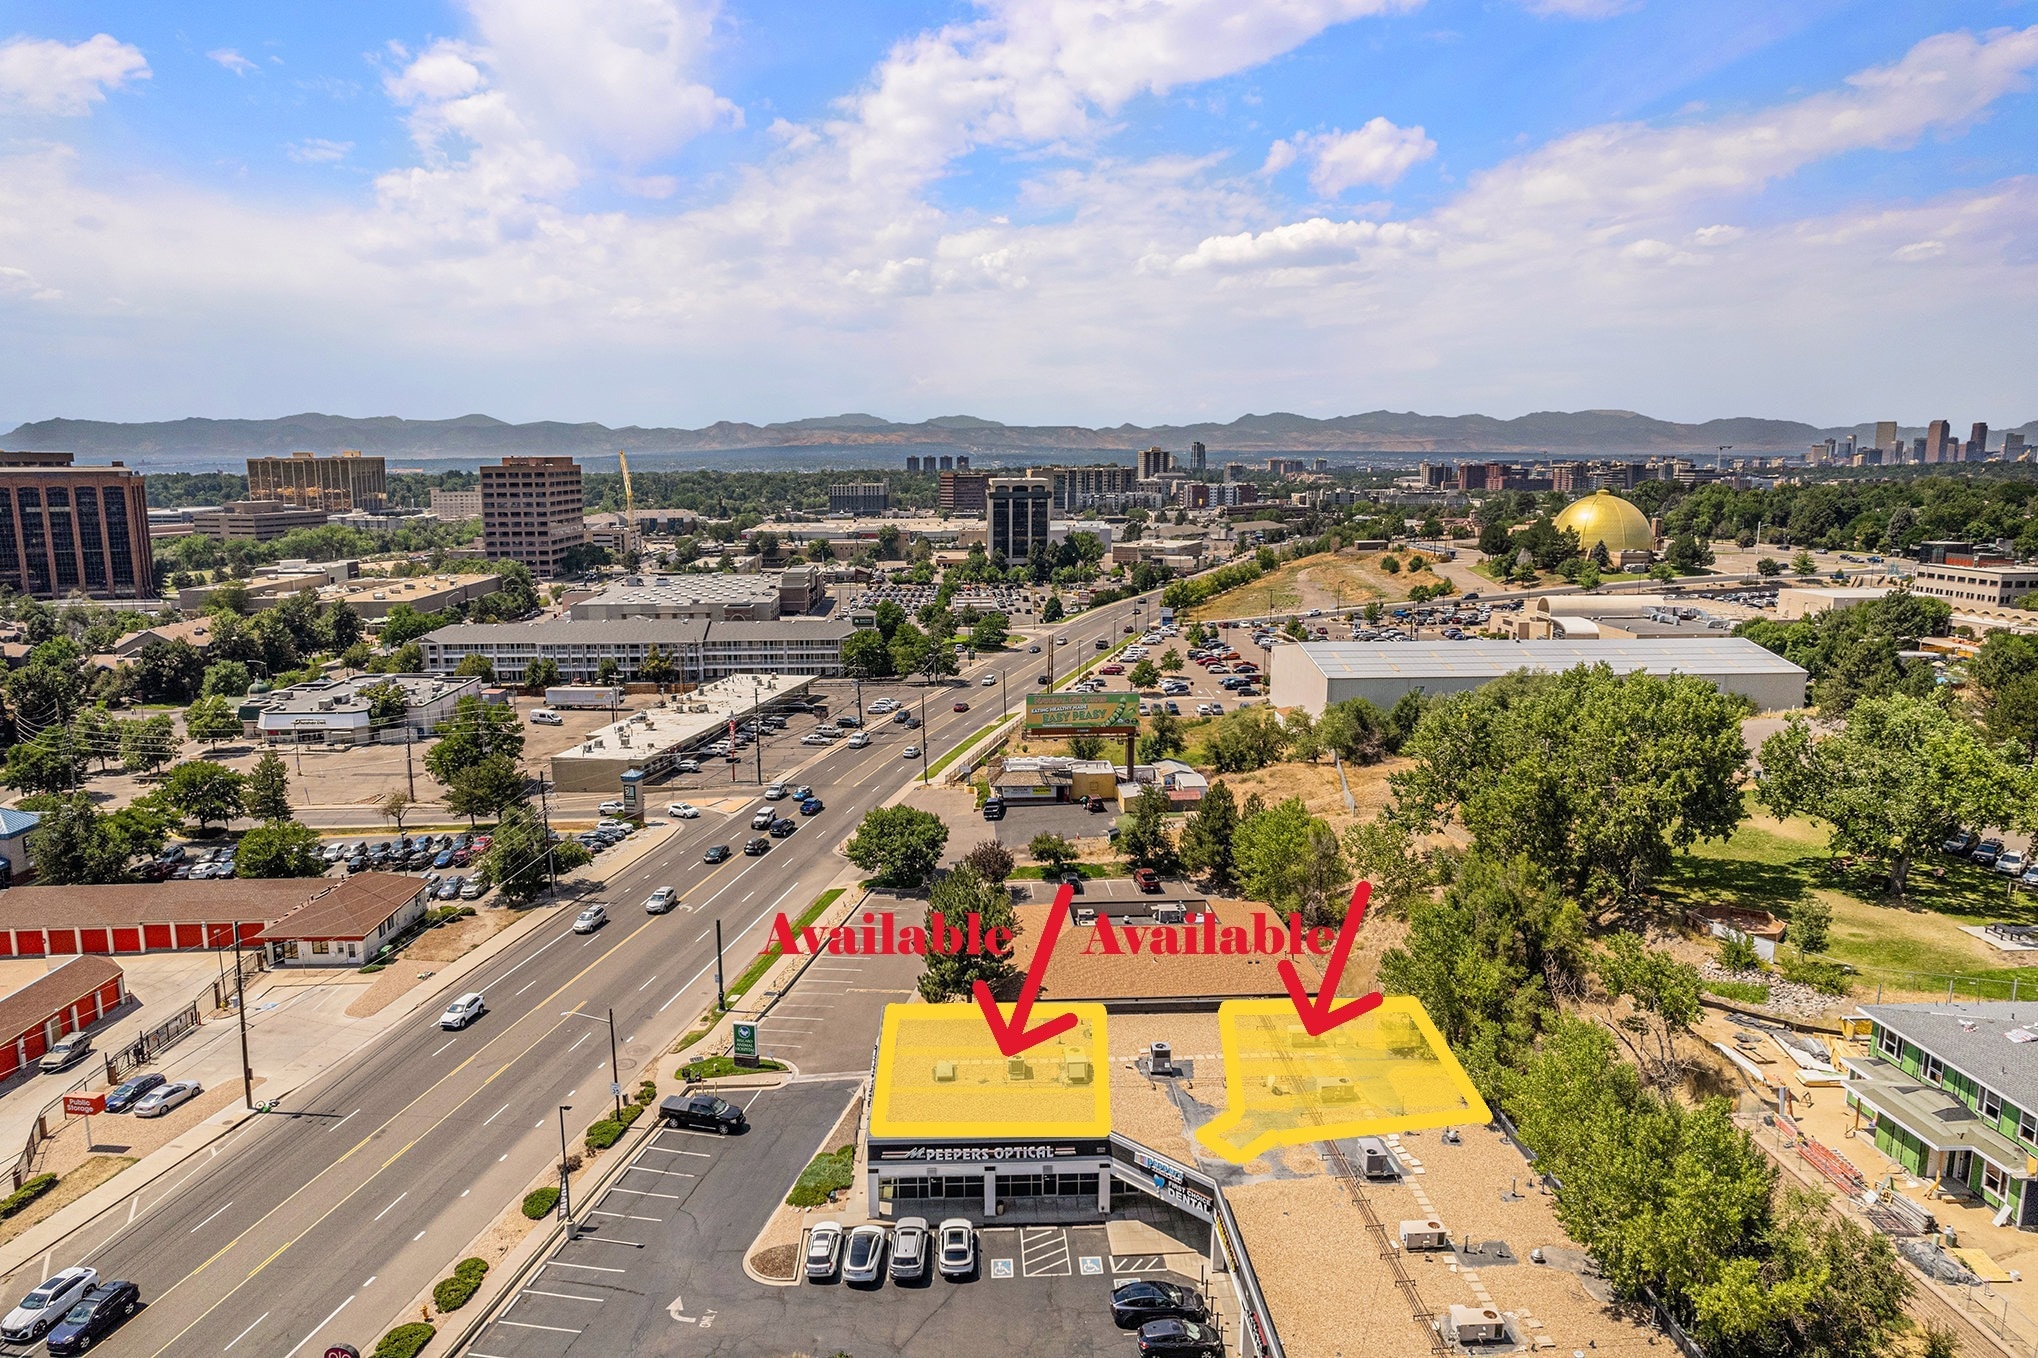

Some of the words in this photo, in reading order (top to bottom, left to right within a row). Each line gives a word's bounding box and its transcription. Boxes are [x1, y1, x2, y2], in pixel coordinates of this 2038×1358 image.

[1043, 712, 1070, 723] EASY
[1073, 709, 1106, 720] PEASY
[67, 1104, 94, 1113] Storage
[926, 1148, 989, 1160] PEEPERS
[994, 1146, 1054, 1159] OPTICAL
[1168, 1180, 1186, 1193] FIRST
[1186, 1190, 1212, 1206] CHOICE
[1168, 1187, 1211, 1215] DENTAL
[699, 1308, 718, 1328] ONLY
